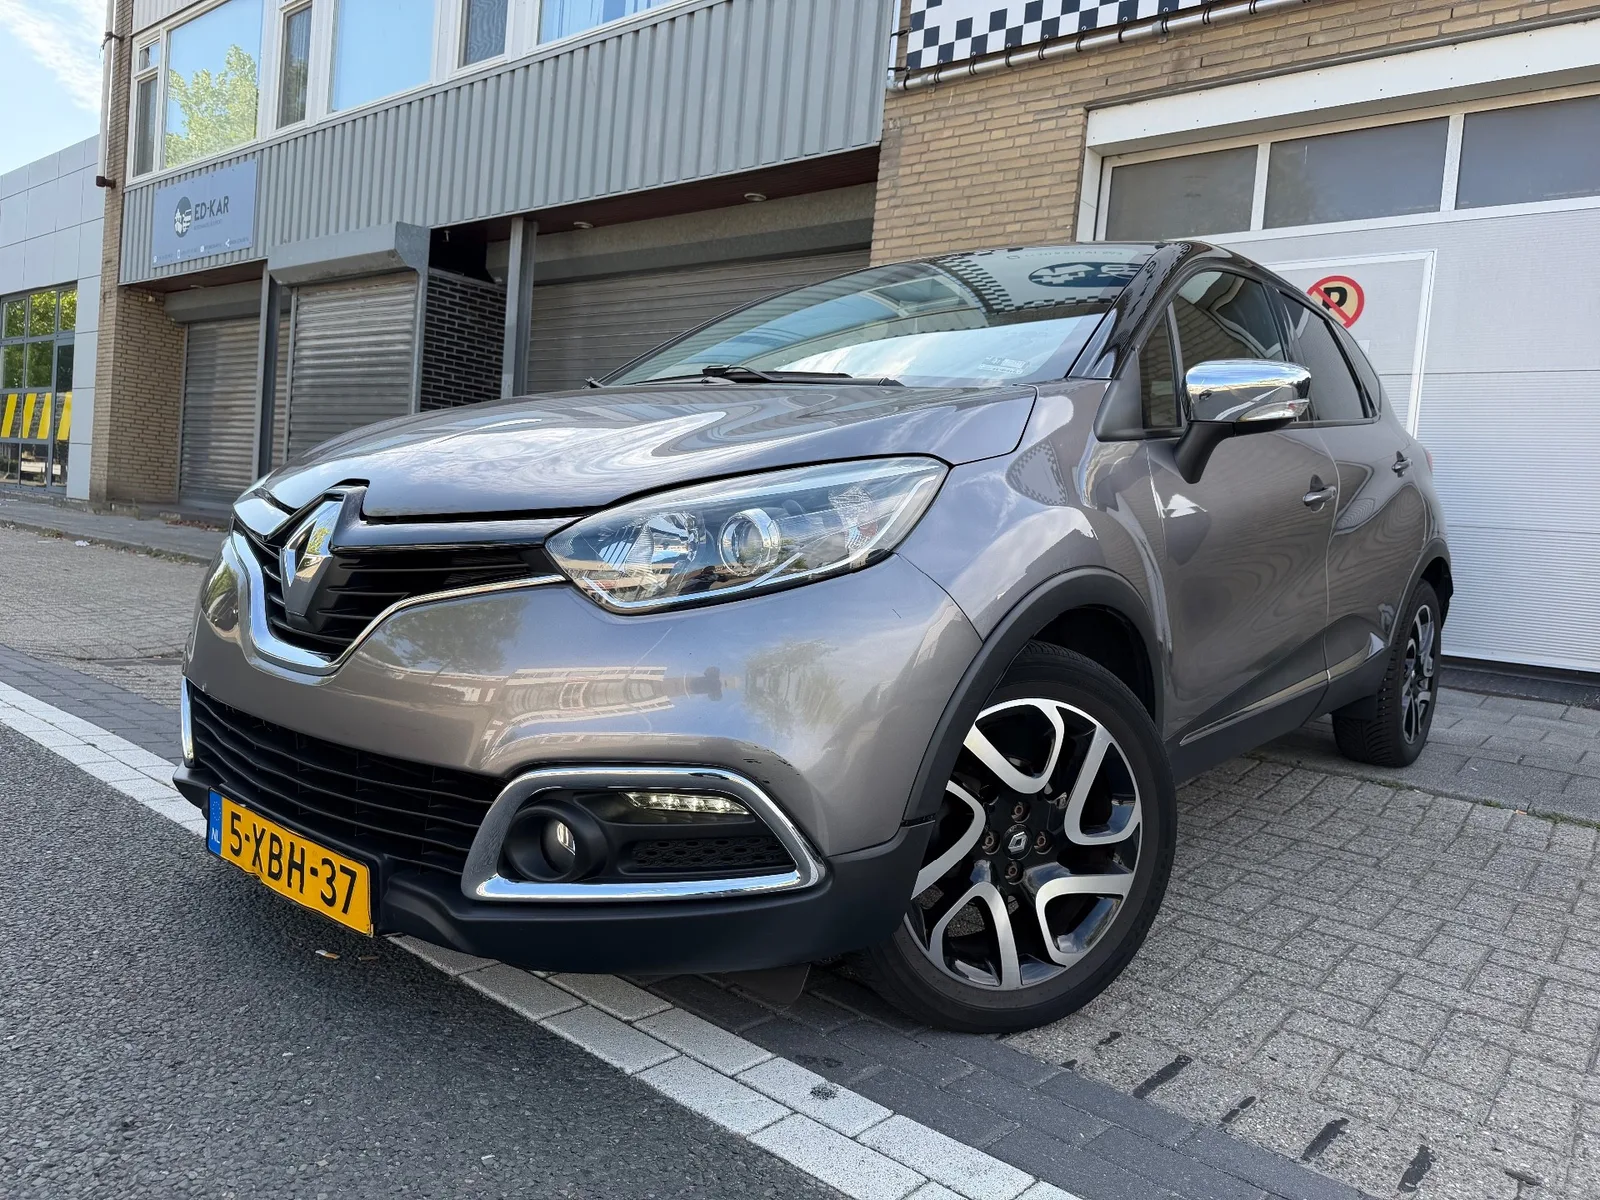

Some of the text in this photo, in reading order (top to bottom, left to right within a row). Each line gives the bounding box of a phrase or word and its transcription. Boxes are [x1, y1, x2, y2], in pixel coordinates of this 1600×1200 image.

[1322, 286, 1348, 311] P
[211, 827, 220, 844] NL
[230, 810, 357, 915] 5-XBH-37
